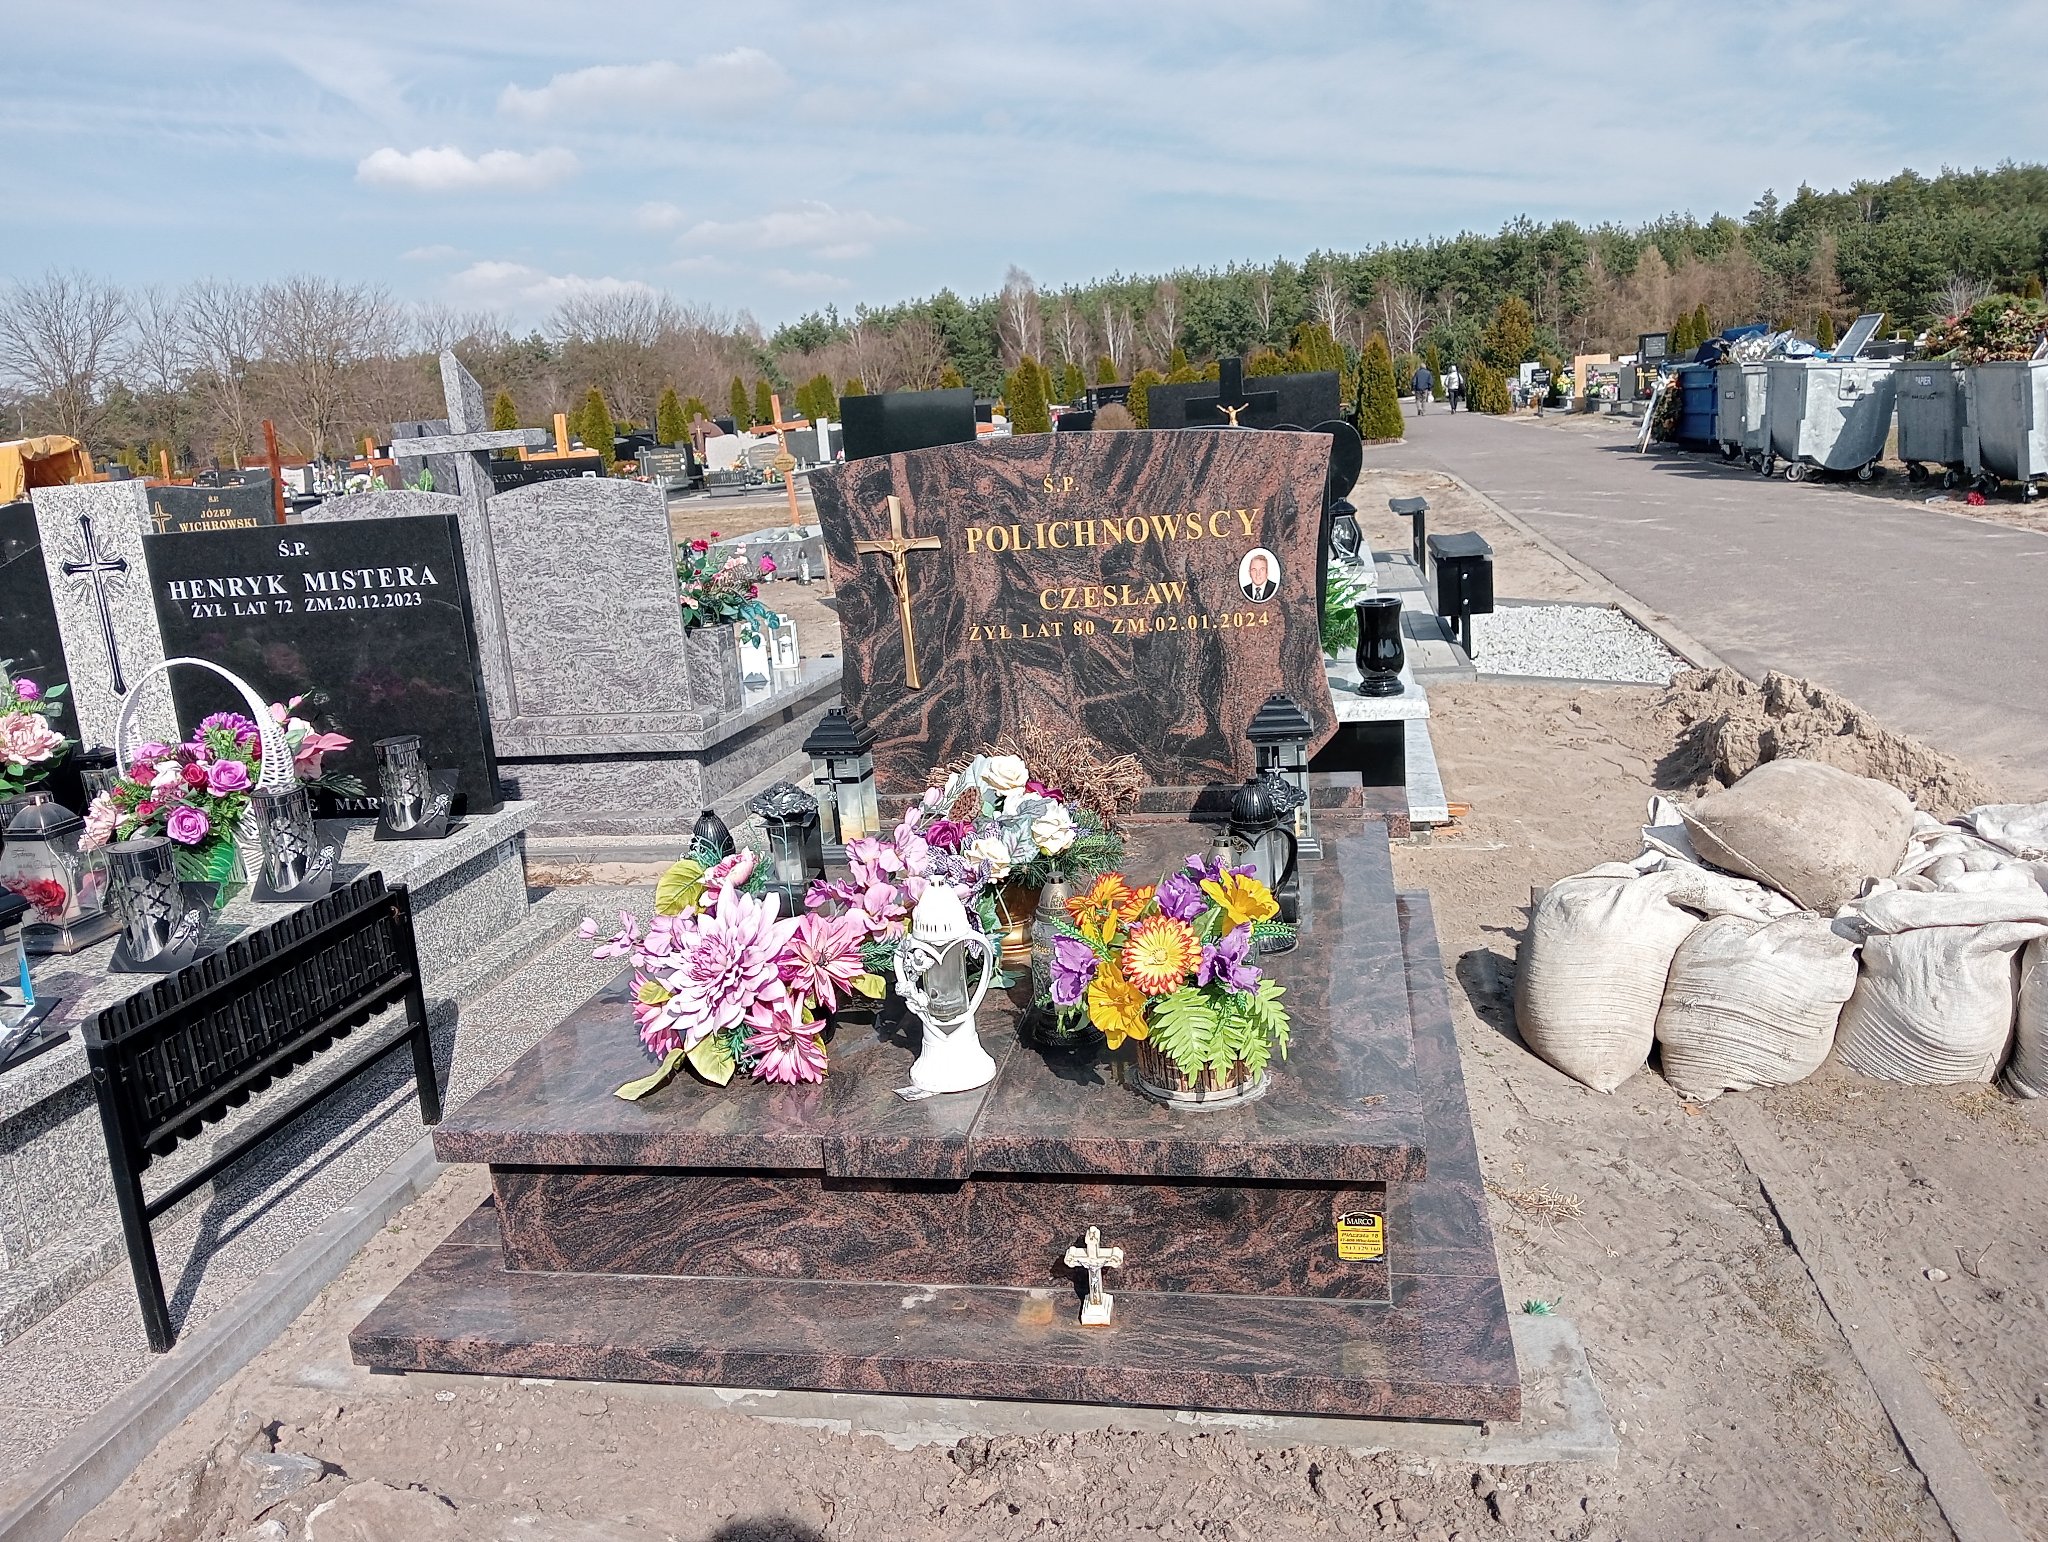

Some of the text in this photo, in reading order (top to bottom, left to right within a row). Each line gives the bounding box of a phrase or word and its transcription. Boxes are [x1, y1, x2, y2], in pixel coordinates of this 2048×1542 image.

[1043, 473, 1080, 494] Ś.P.
[179, 517, 258, 533] WICHROWSKI
[200, 508, 232, 519] JÓZEF
[965, 508, 1262, 555] POLICHNOWSCY
[278, 539, 310, 557] Ś.P.
[168, 565, 439, 601] HENRYK MISTERA
[191, 592, 422, 619] ŻYŁ LAT 72 ZM.20.12.2023
[1039, 580, 1188, 611] CZESŁAW
[969, 610, 1270, 642] ŻYŁ LAT 80 ZM.02.01.2024
[335, 796, 384, 811] MAR
